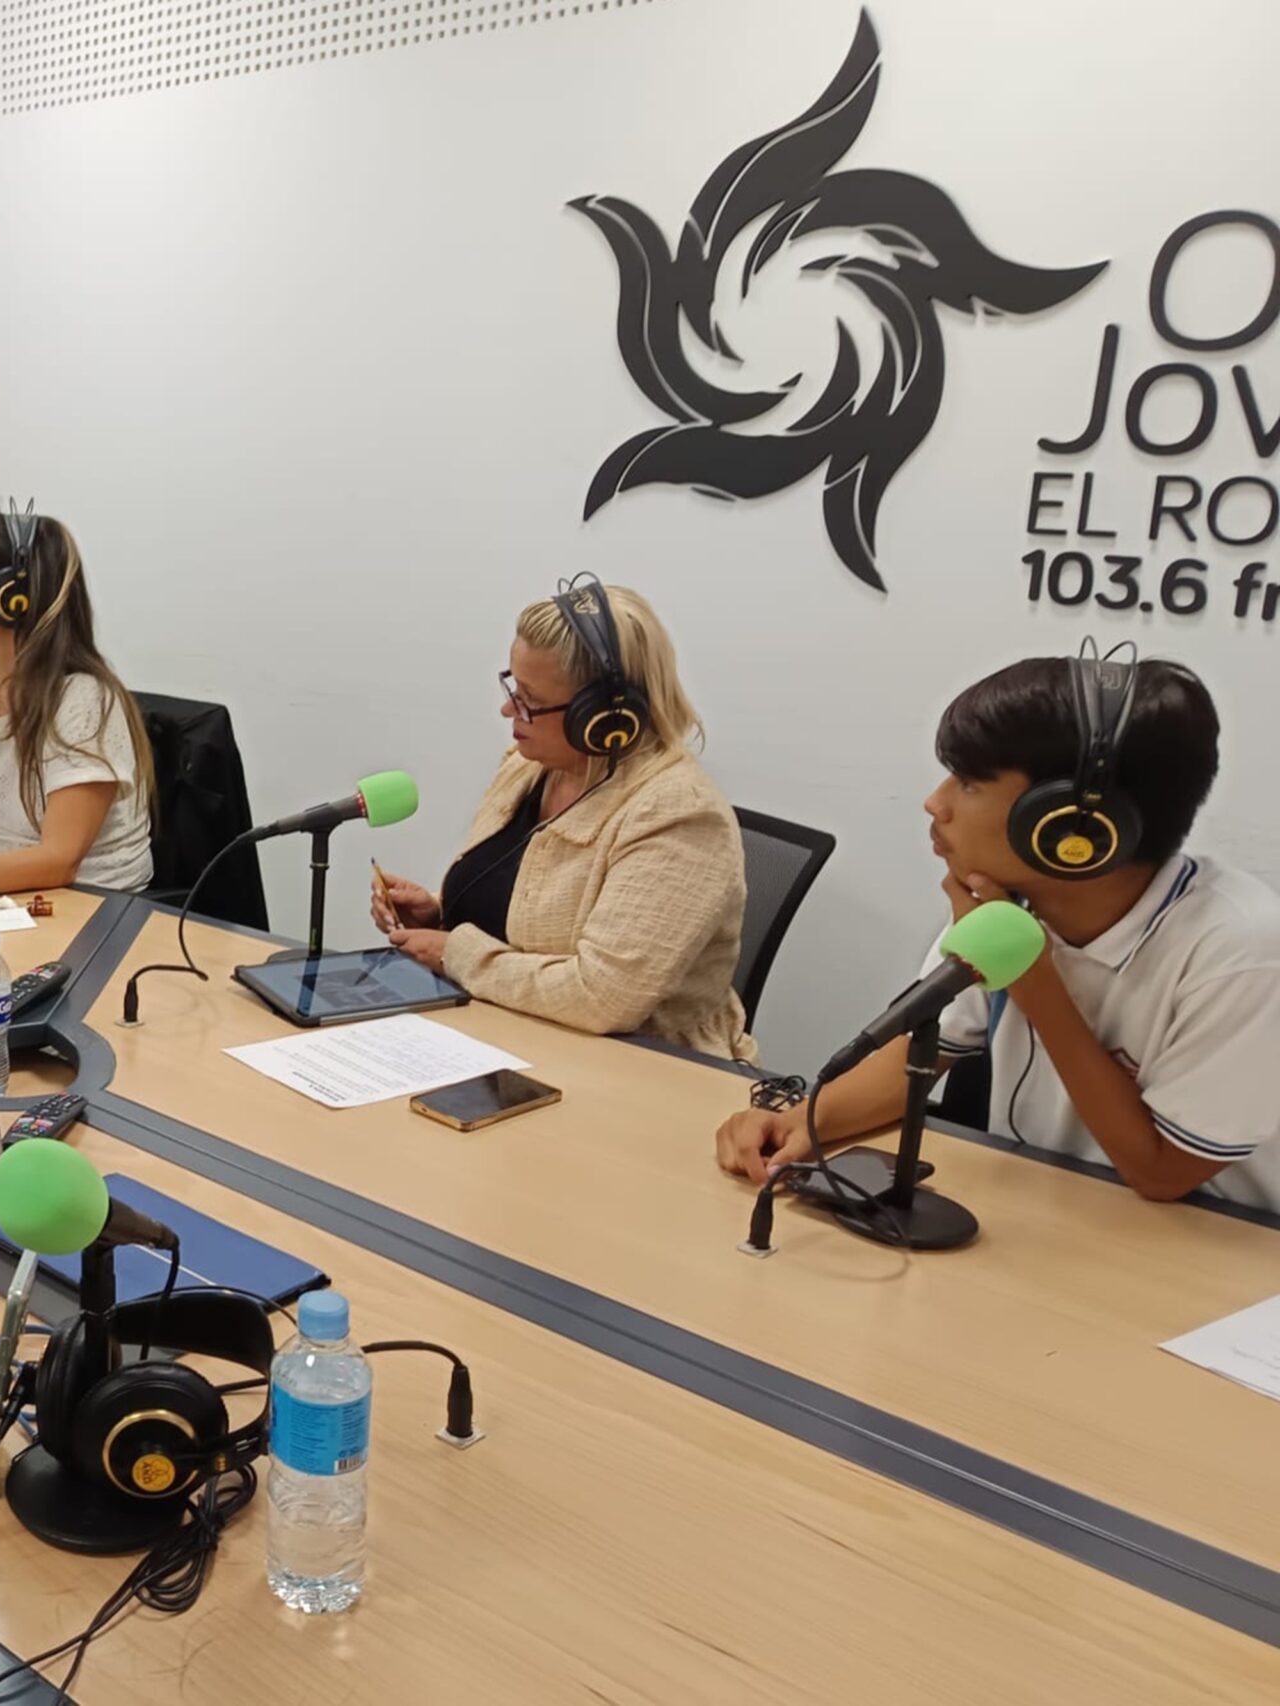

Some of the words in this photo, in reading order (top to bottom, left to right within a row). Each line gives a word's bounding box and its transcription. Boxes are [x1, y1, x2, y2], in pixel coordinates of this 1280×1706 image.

[1026, 472, 1117, 538] EL
[1149, 475, 1280, 545] RO
[1021, 549, 1209, 615] 103.6
